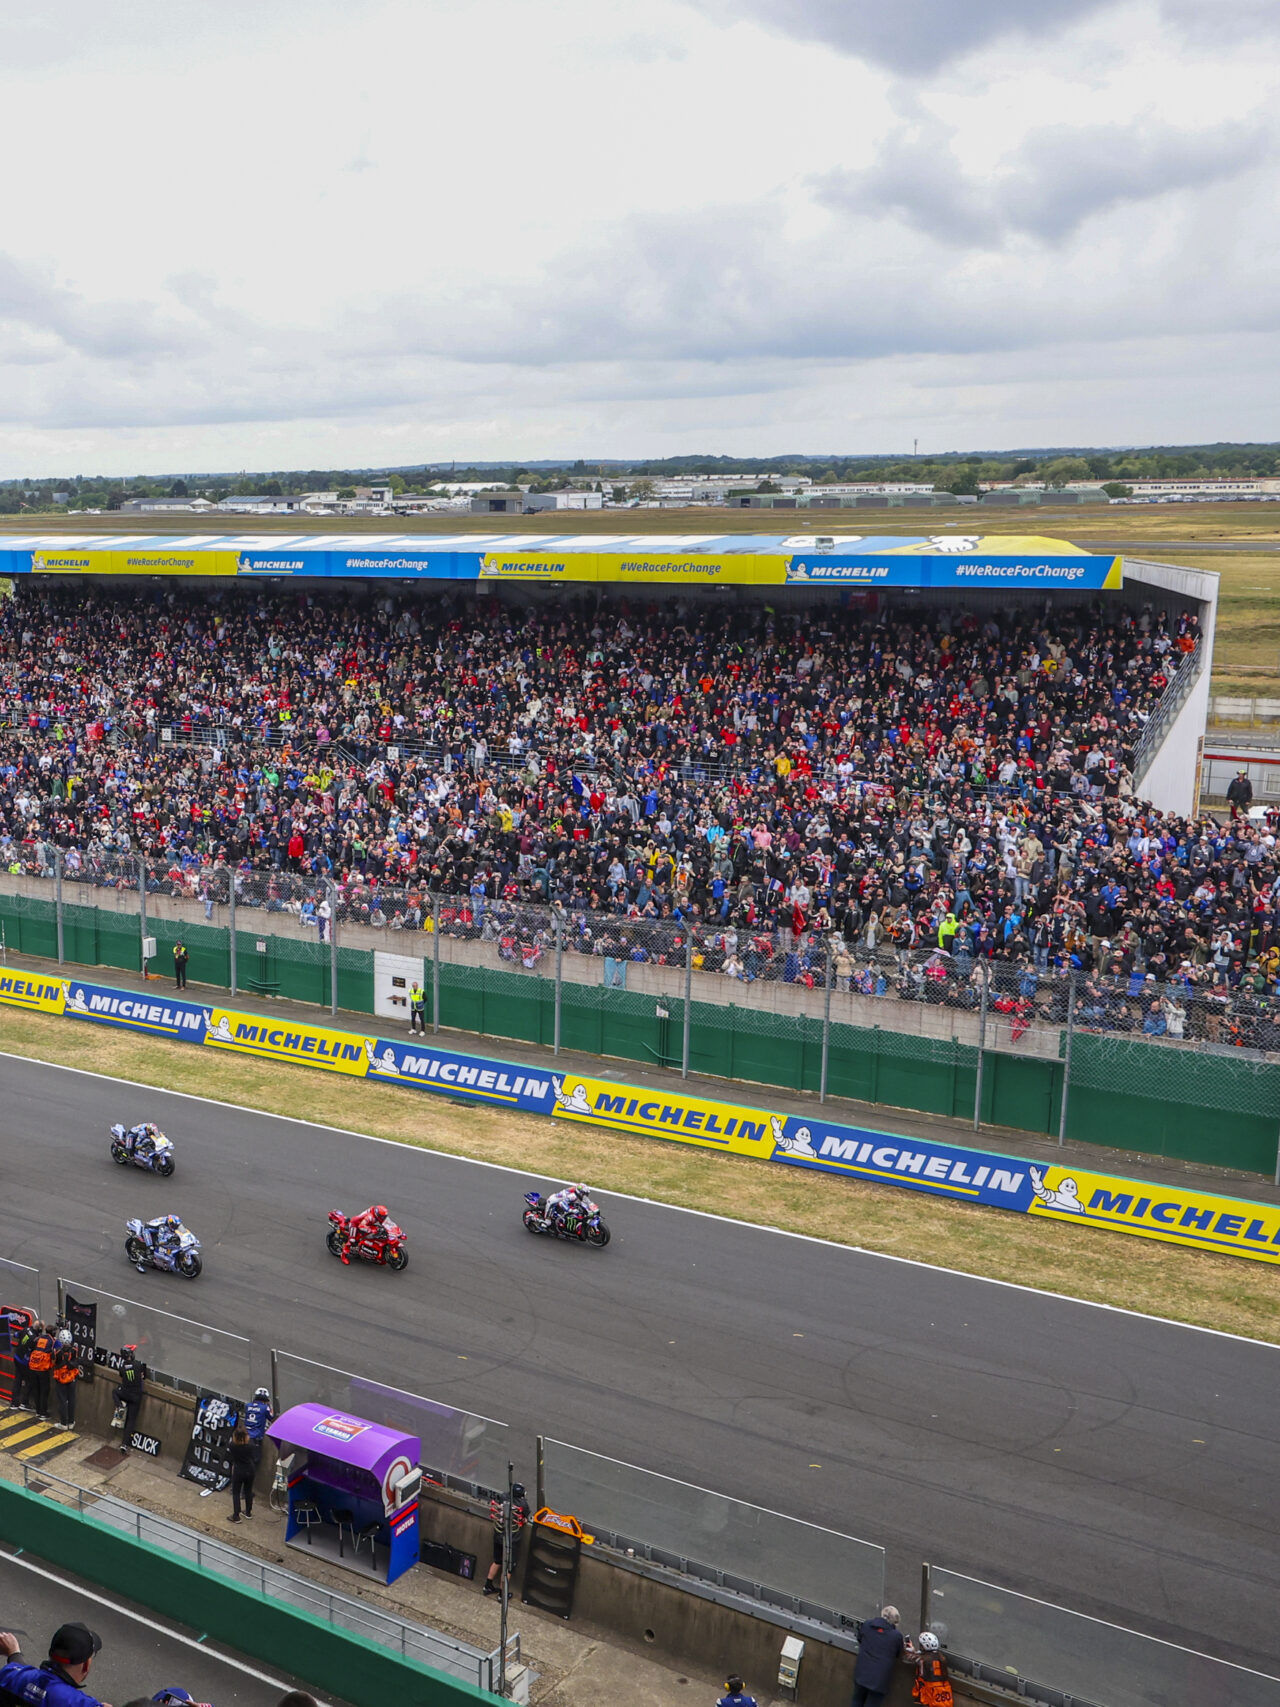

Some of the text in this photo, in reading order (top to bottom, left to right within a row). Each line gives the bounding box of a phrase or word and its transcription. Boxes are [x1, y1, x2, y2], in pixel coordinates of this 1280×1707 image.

[46, 558, 90, 567] MICHELIN
[126, 557, 195, 568] #WeRaceForChange
[253, 560, 304, 570] MICHELIN
[345, 558, 429, 572] #WeRaceForChange
[501, 562, 566, 573] MICHELIN
[619, 561, 722, 576] #WeRaceForChange
[811, 566, 889, 578] MICHELIN
[955, 563, 1086, 580] #WeRaceForChange
[88, 994, 203, 1031] MICHELIN
[234, 1023, 363, 1062] MICHELIN
[400, 1054, 550, 1099] MICHELIN
[594, 1092, 768, 1142] MICHELIN
[819, 1134, 1025, 1194] MICHELIN
[131, 1432, 159, 1456] SLICK
[395, 1516, 416, 1538] MOTUL
